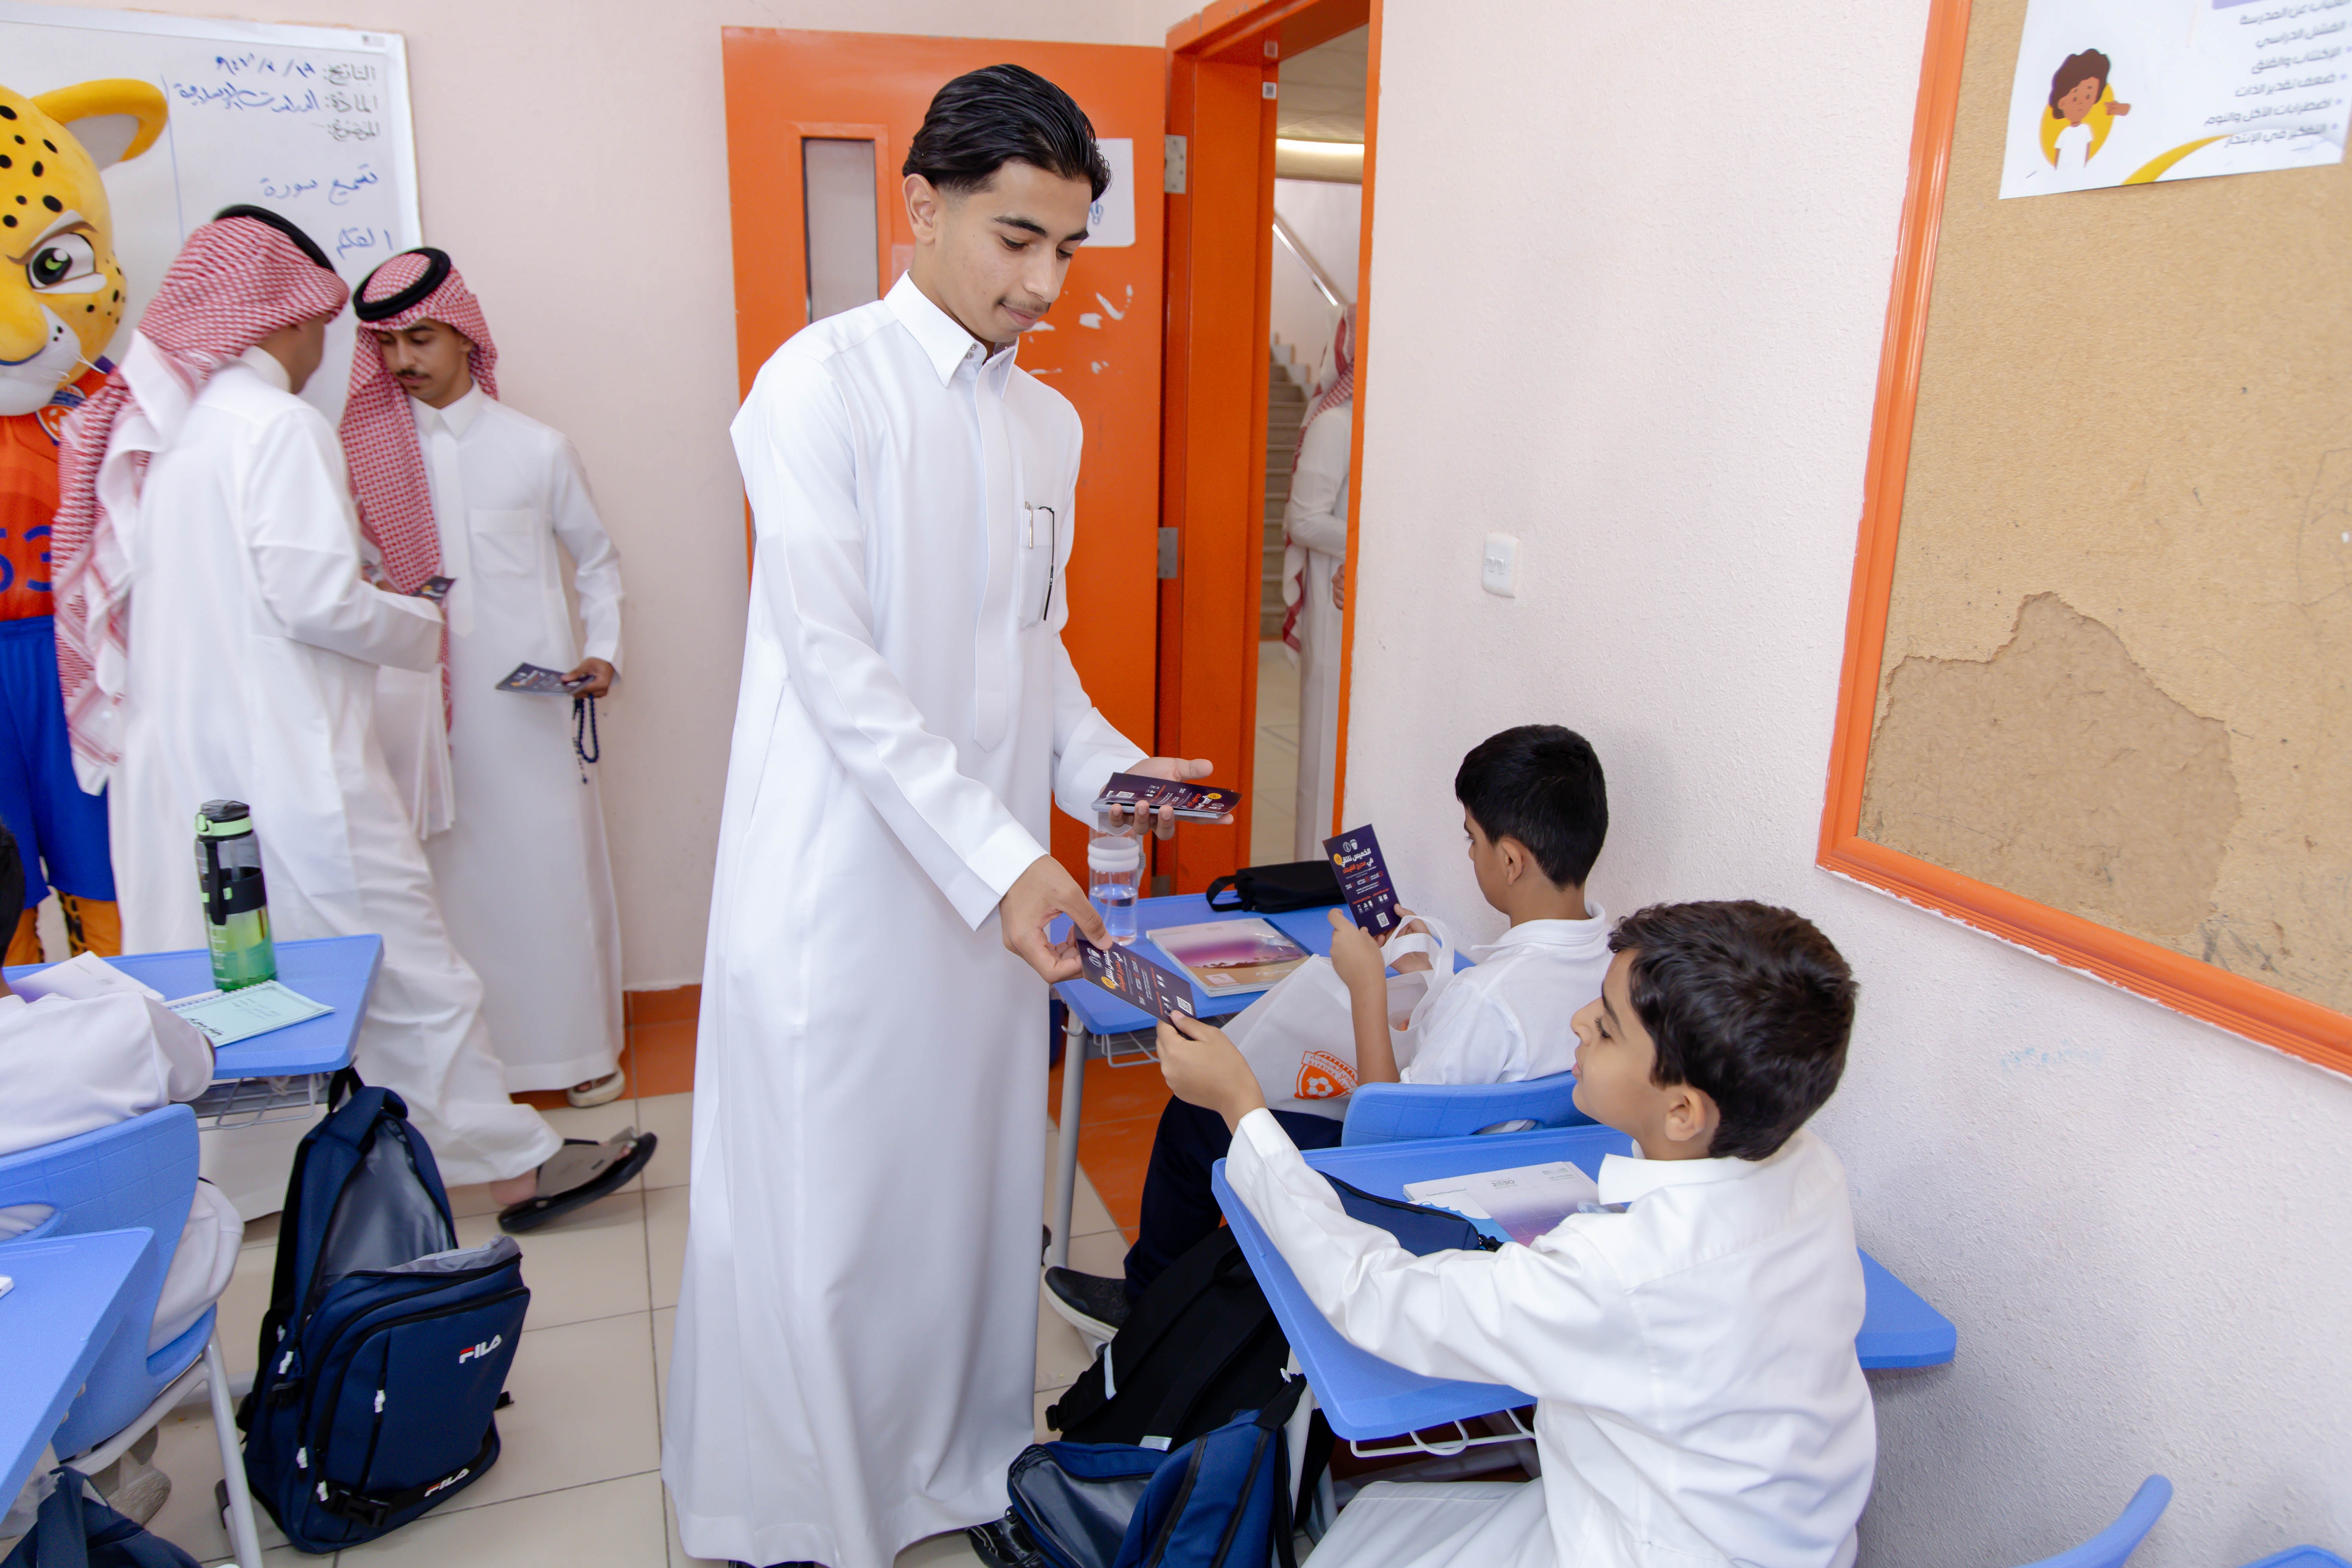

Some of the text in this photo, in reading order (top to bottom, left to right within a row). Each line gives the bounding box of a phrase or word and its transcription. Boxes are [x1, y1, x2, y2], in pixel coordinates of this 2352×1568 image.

[2239, 7, 2288, 25] المدرسة
[2256, 20, 2346, 48] الفشل الدراسي
[2235, 74, 2336, 97] ضعف تقدير الذات
[2204, 112, 2241, 127] والنوم
[2263, 131, 2287, 142] في
[2286, 123, 2327, 140] التفكير
[260, 177, 318, 199] سورة
[1341, 855, 1352, 868] نلتقي
[1352, 848, 1372, 862] الخميس
[1367, 857, 1374, 867] في
[459, 1334, 503, 1364] FILA
[424, 1468, 470, 1497] FILA
